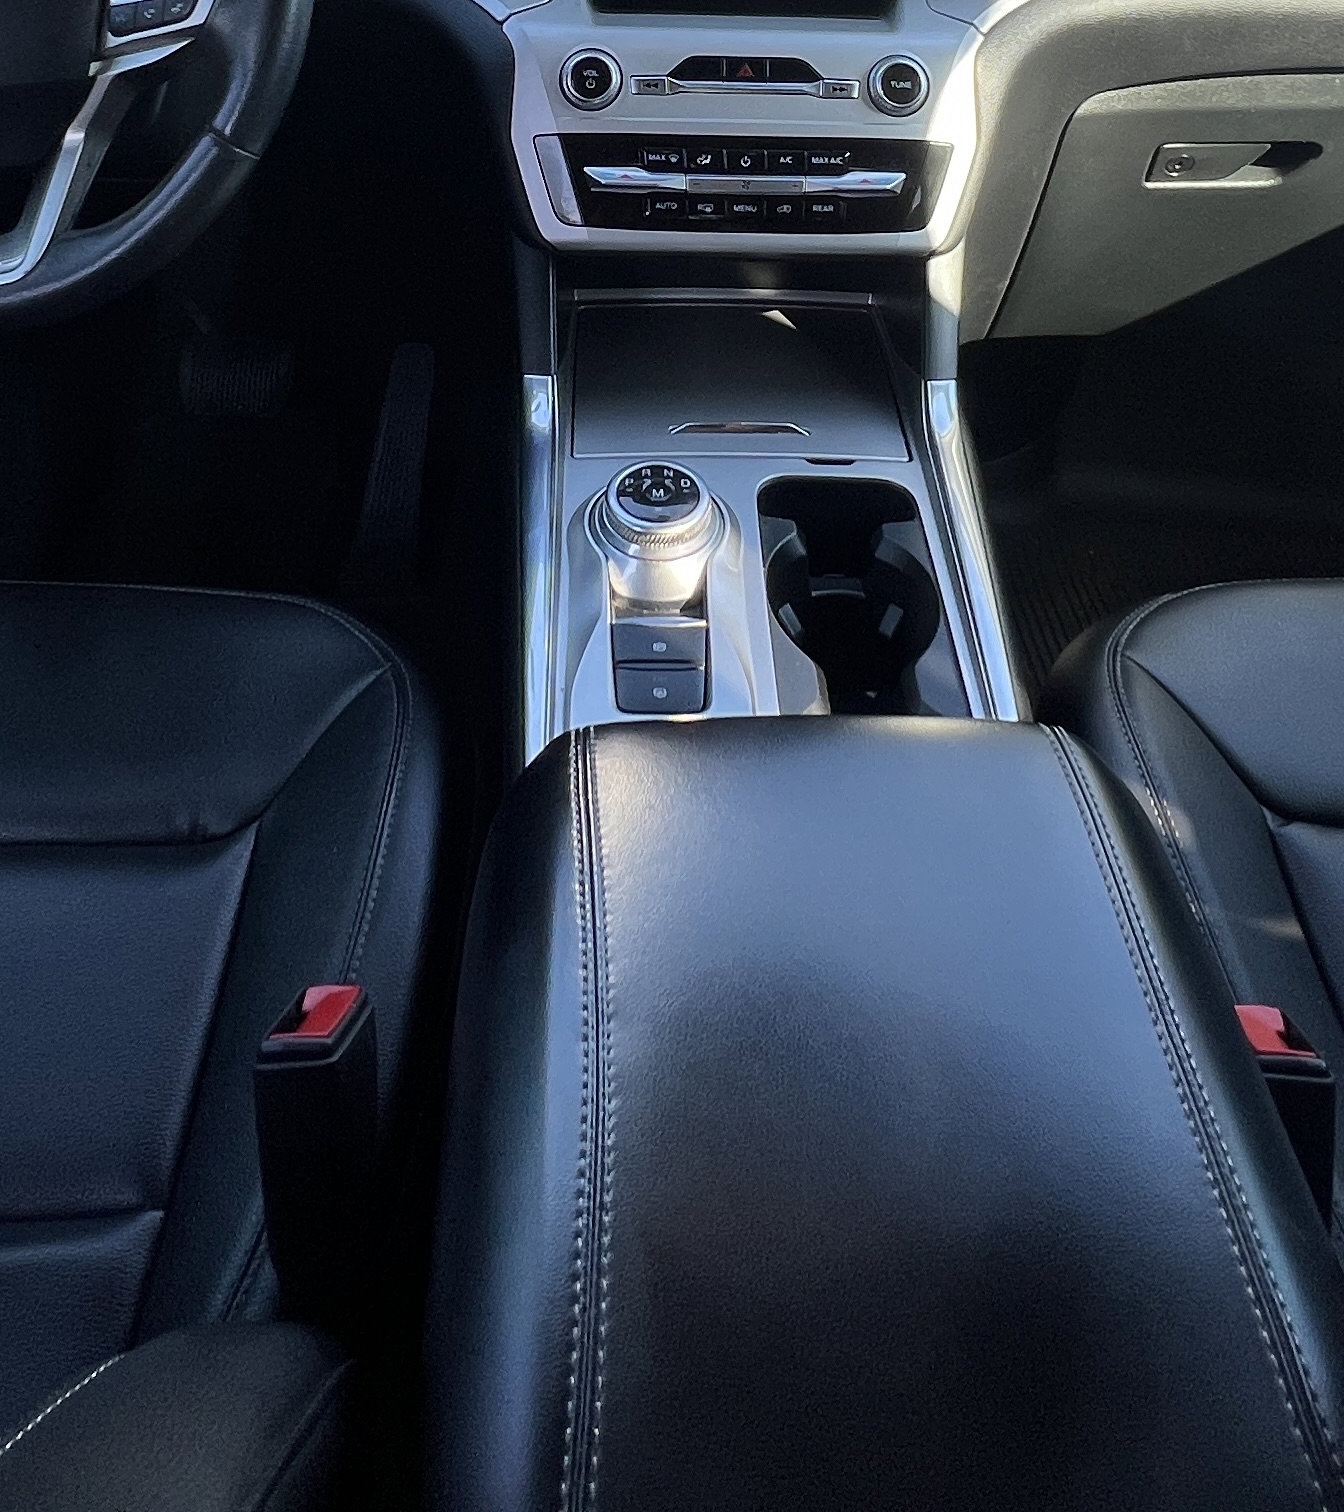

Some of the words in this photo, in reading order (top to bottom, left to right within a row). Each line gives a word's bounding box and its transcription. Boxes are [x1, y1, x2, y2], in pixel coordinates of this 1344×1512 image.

[582, 69, 600, 77] VOL
[890, 80, 913, 89] TUNE
[648, 153, 667, 161] MAX
[779, 156, 793, 164] A/C
[811, 156, 829, 164] MAX
[656, 201, 678, 210] AUTO
[733, 204, 757, 213] MENU
[812, 204, 834, 213] REAR
[663, 468, 674, 478] N
[624, 477, 634, 487] P
[680, 478, 691, 488] D
[652, 488, 665, 499] M
